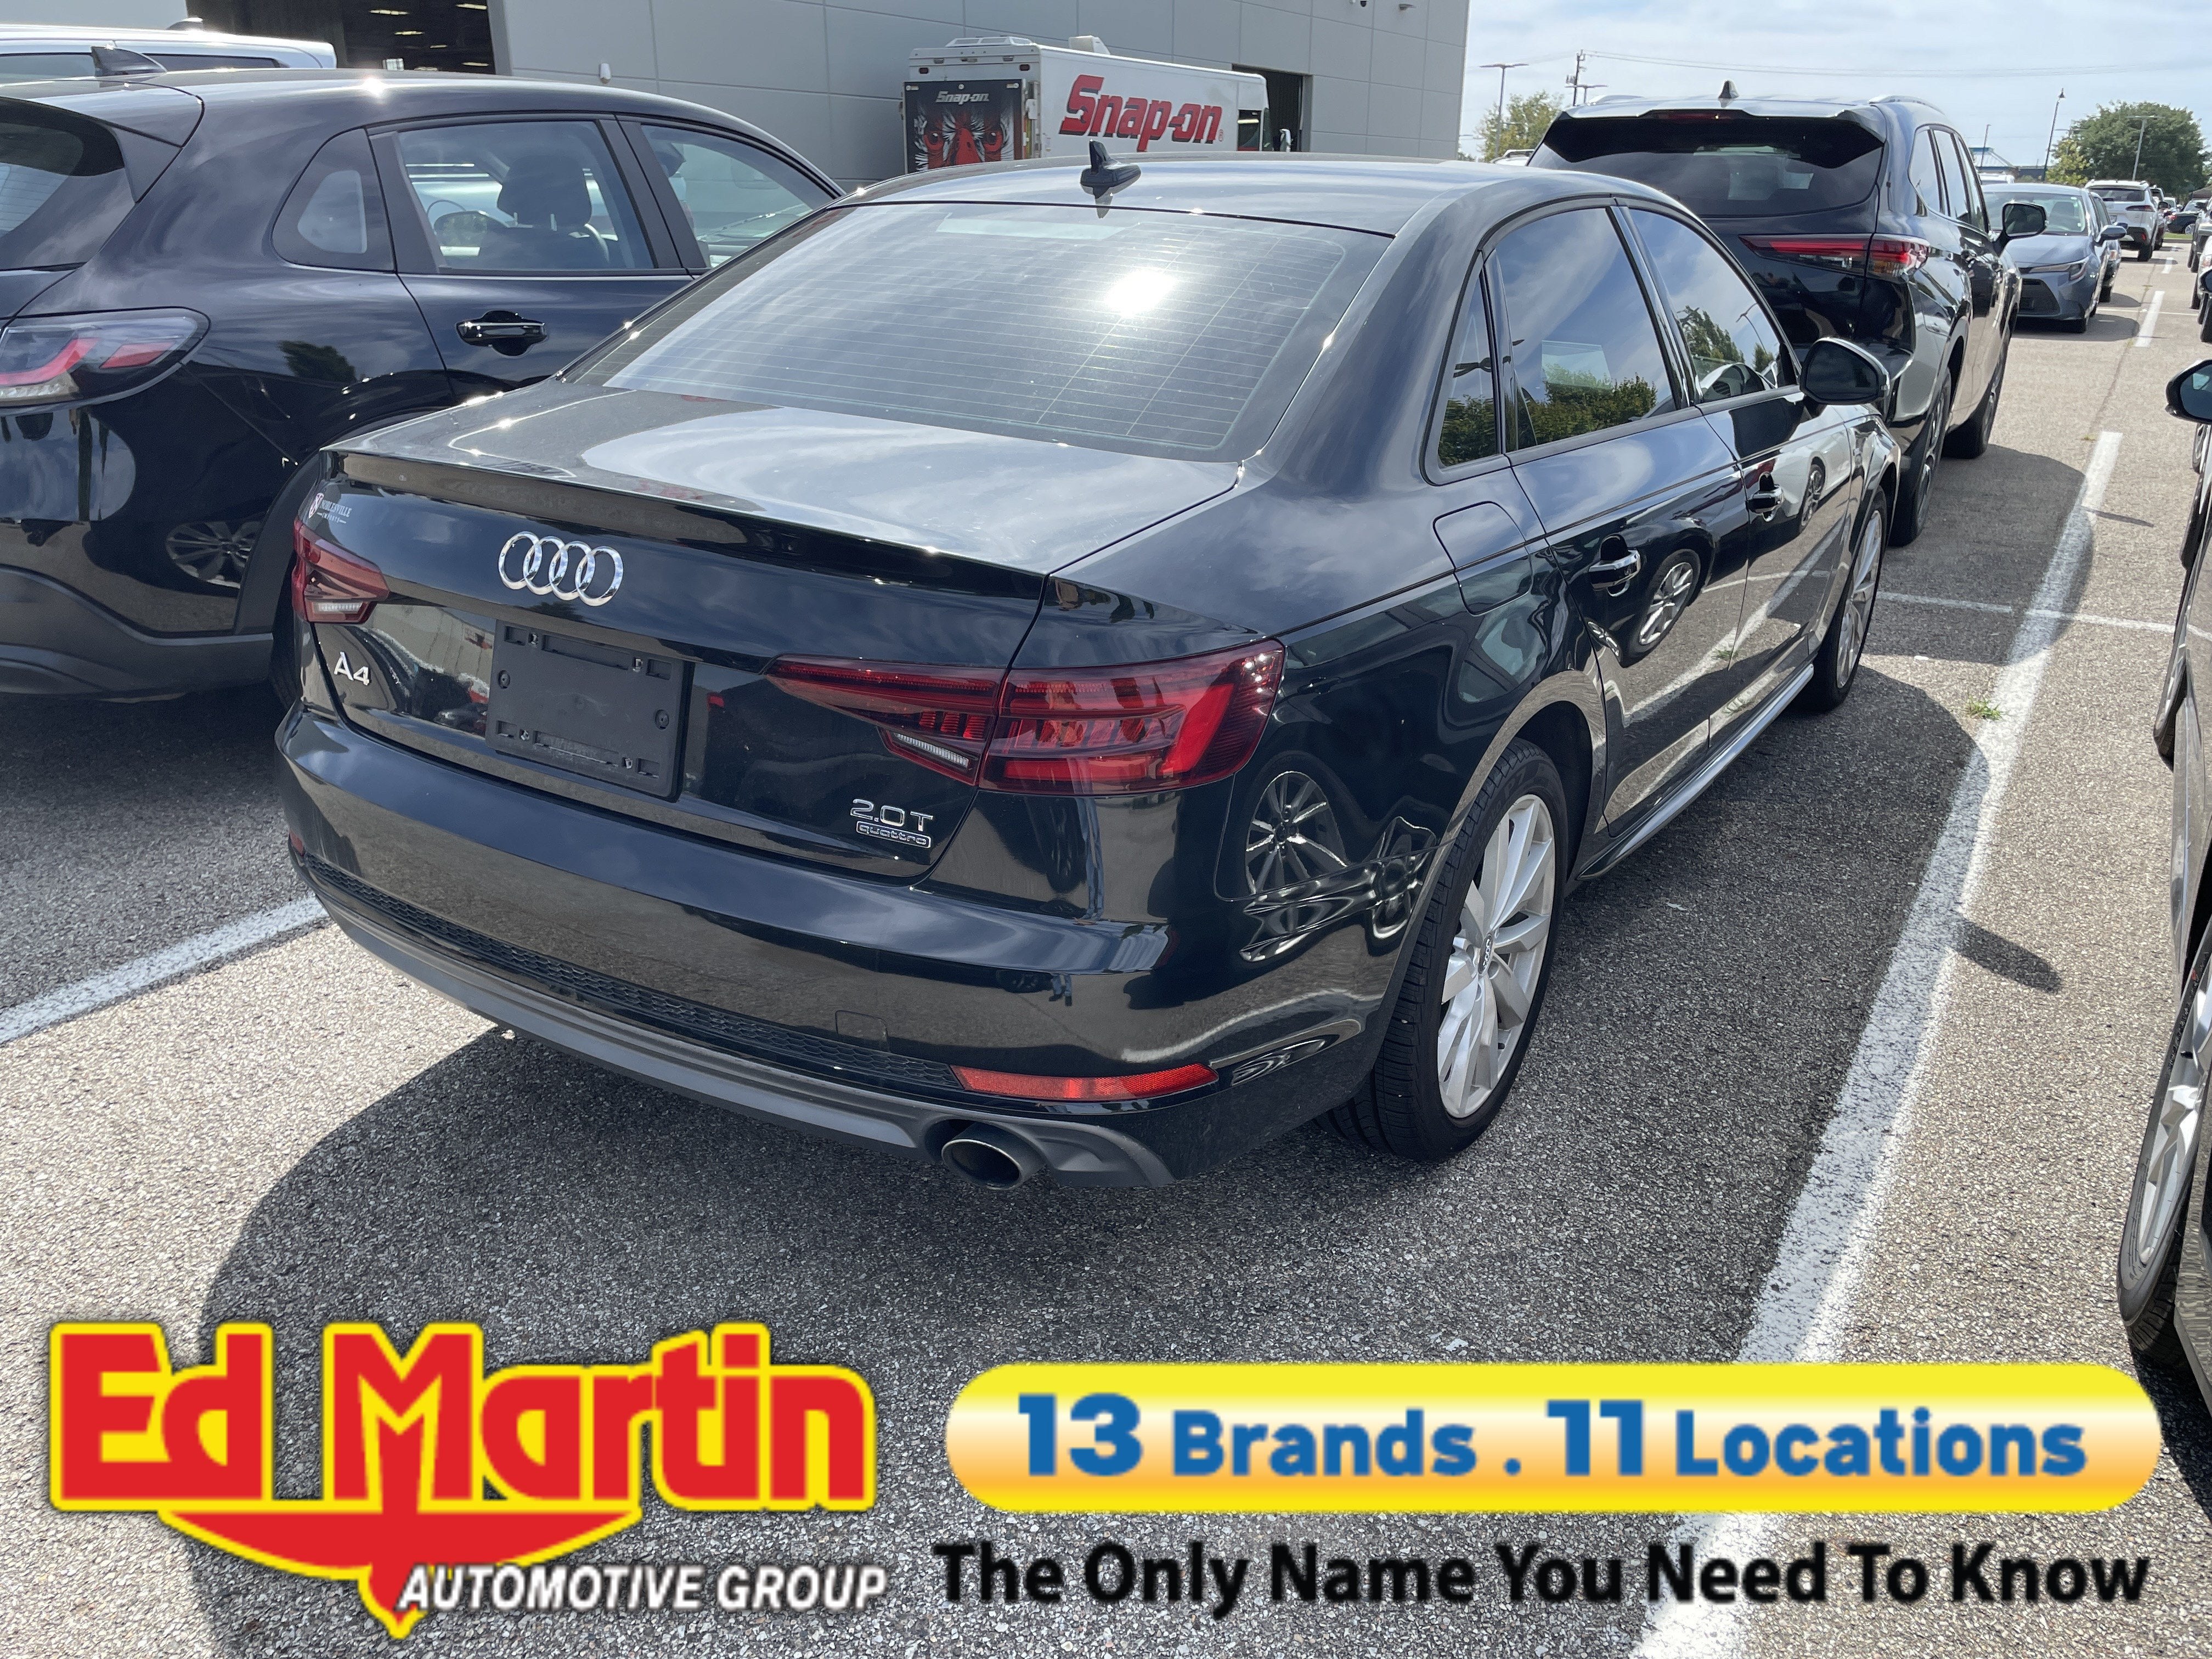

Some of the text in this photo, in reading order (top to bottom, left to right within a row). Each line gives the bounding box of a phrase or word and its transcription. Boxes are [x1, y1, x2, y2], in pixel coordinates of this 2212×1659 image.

[935, 91, 990, 105] Snap-on
[1058, 74, 1223, 153] Snap-on
[319, 499, 352, 517] NOBLESVILLE
[334, 651, 370, 686] A4
[859, 824, 927, 845] quattro
